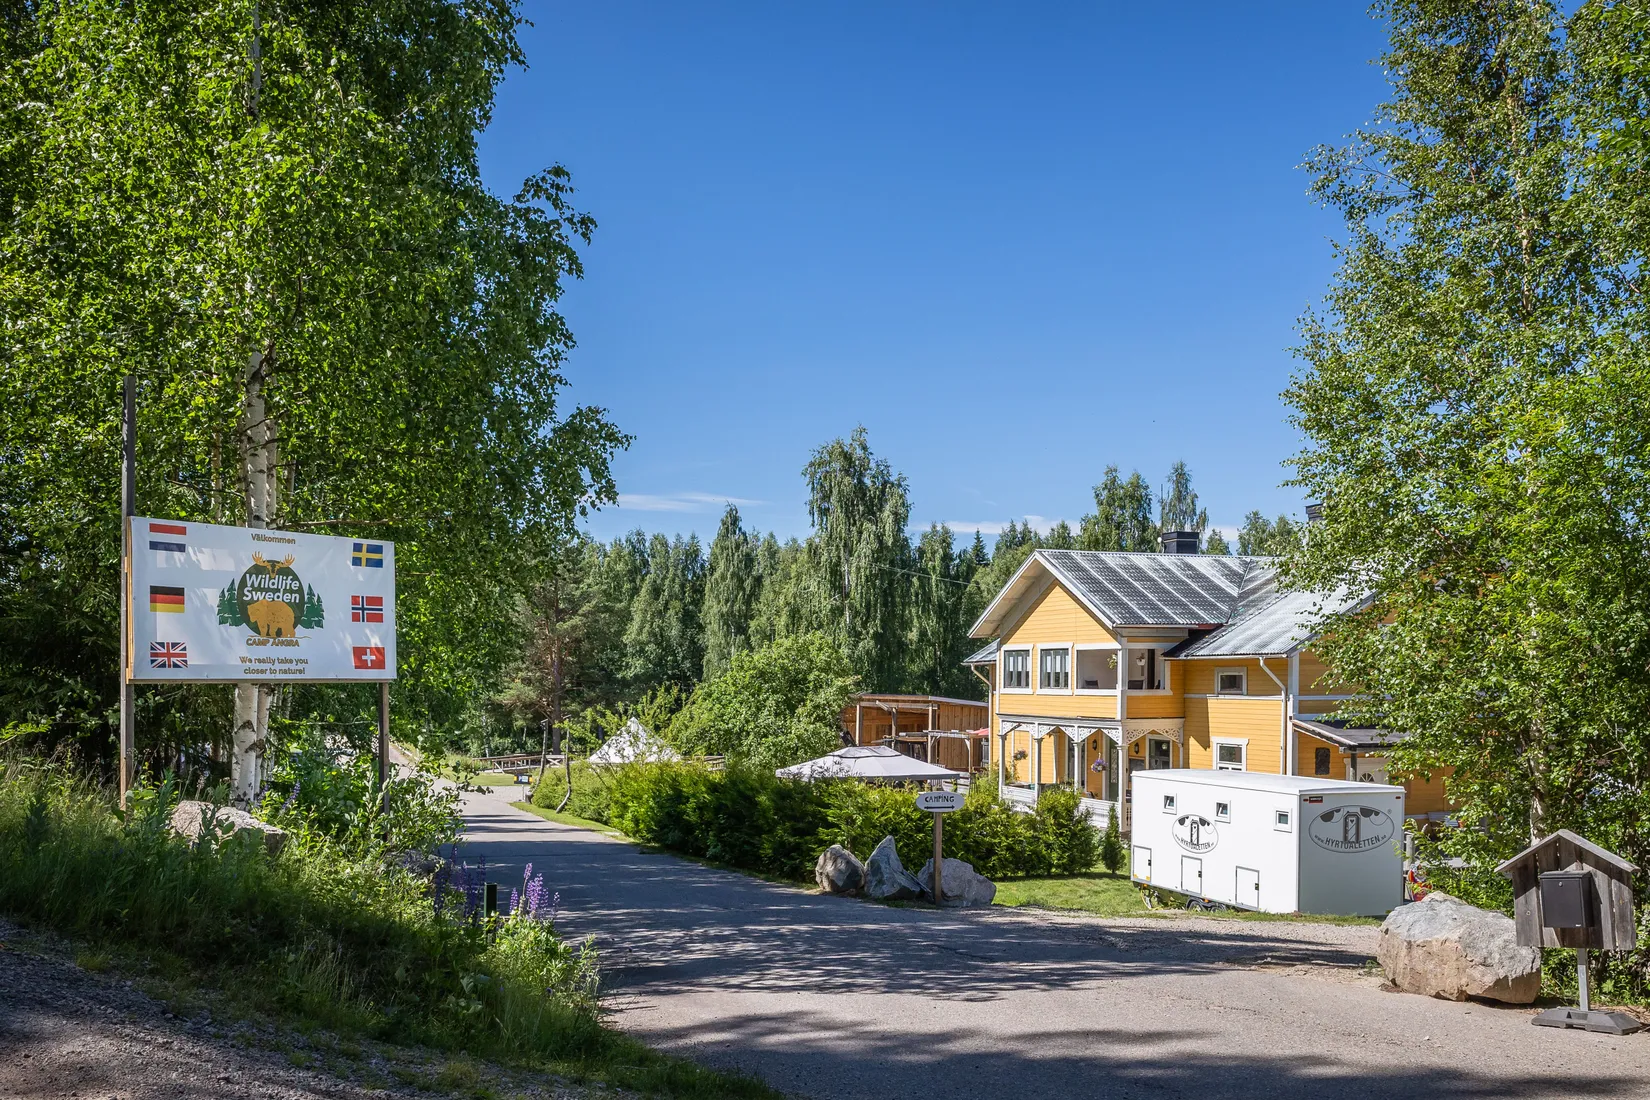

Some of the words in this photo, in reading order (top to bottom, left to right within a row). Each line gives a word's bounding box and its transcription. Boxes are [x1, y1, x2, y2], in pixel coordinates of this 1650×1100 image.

[251, 533, 296, 544] Välkommen
[246, 574, 299, 590] Wildlife
[243, 587, 299, 602] Sweden
[246, 638, 270, 646] CAMP
[239, 656, 253, 664] We
[254, 656, 276, 666] really
[295, 658, 309, 666] you
[243, 667, 268, 675] closer
[269, 667, 278, 675] to
[278, 667, 306, 675] nature!
